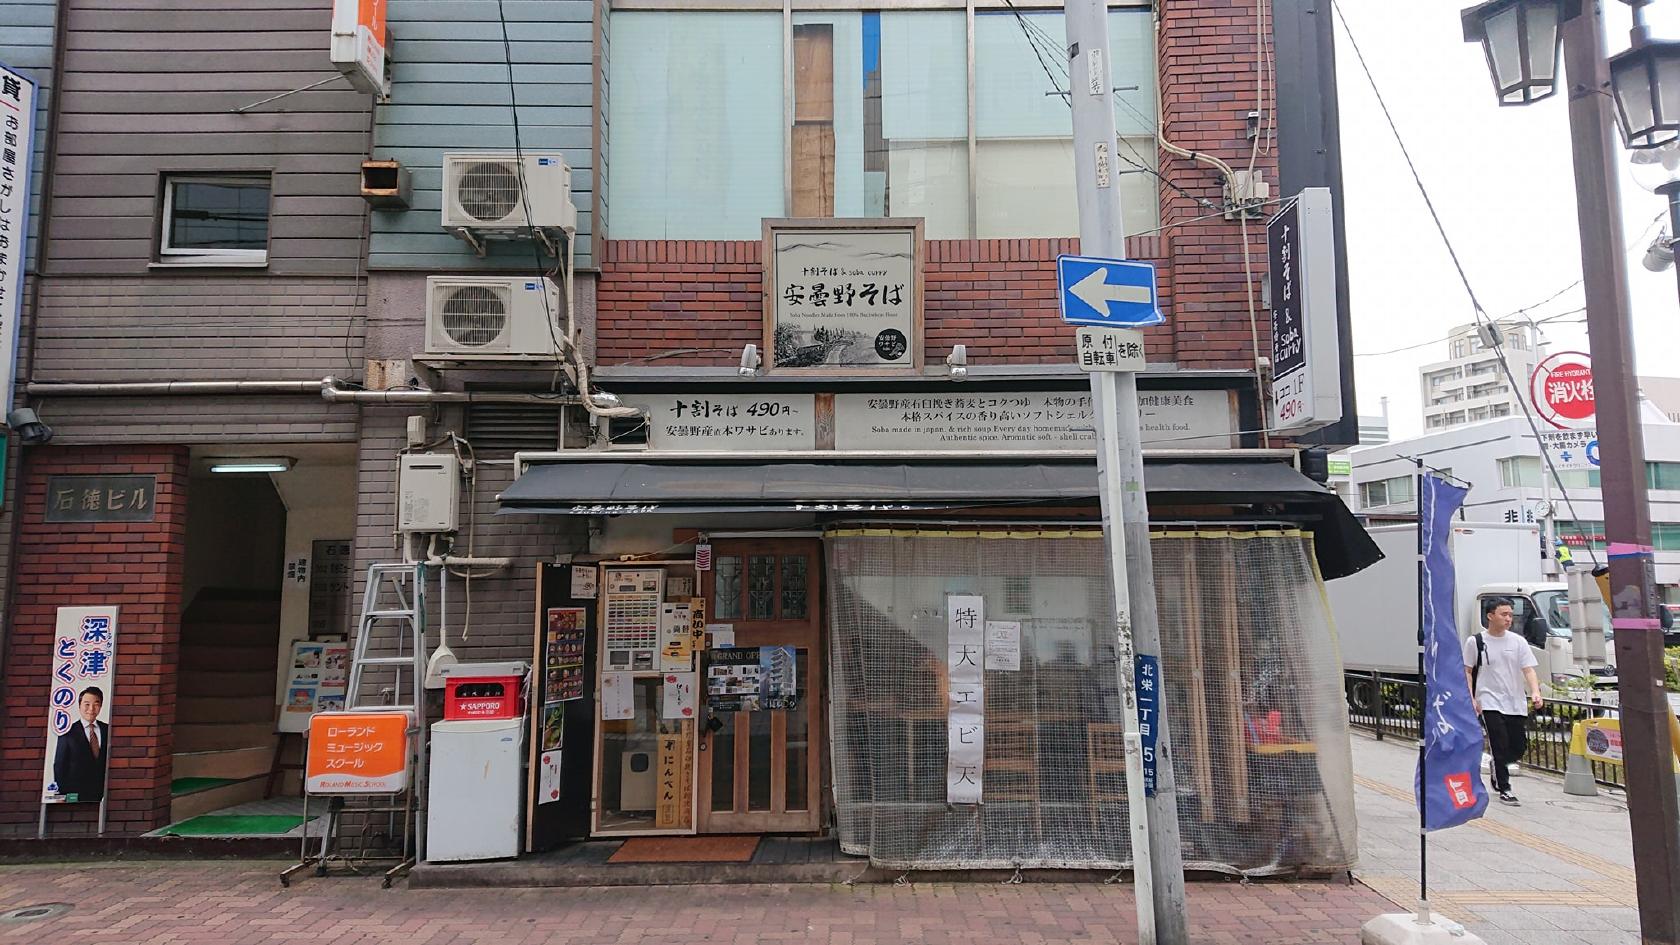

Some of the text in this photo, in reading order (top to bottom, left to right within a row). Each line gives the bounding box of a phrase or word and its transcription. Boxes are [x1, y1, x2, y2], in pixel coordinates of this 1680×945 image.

[801, 266, 838, 277] 十割そば
[867, 269, 888, 277] curry
[783, 282, 905, 307] 安曇野そば
[1081, 334, 1113, 349] 原付
[1083, 350, 1116, 366] 自転車
[1117, 342, 1144, 359] を除く
[1551, 369, 1564, 378] FIRE
[669, 399, 739, 418] 十割そば
[1001, 433, 1037, 441] Aromatic
[1060, 432, 1078, 440] shell
[1017, 425, 1031, 434] day
[692, 609, 704, 639] 商い中
[82, 617, 109, 676] 深津
[53, 638, 76, 732] とくのり
[953, 607, 978, 786] 特大エビ天
[1140, 663, 1153, 737] 北栄一丁目
[467, 702, 500, 710] SAPPORO
[328, 726, 376, 738] ローランド
[326, 742, 384, 753] ミュージック
[1143, 747, 1153, 762] 5
[325, 758, 366, 769] スクール
[319, 780, 344, 788] ROLAND
[663, 755, 675, 801] にんべん
